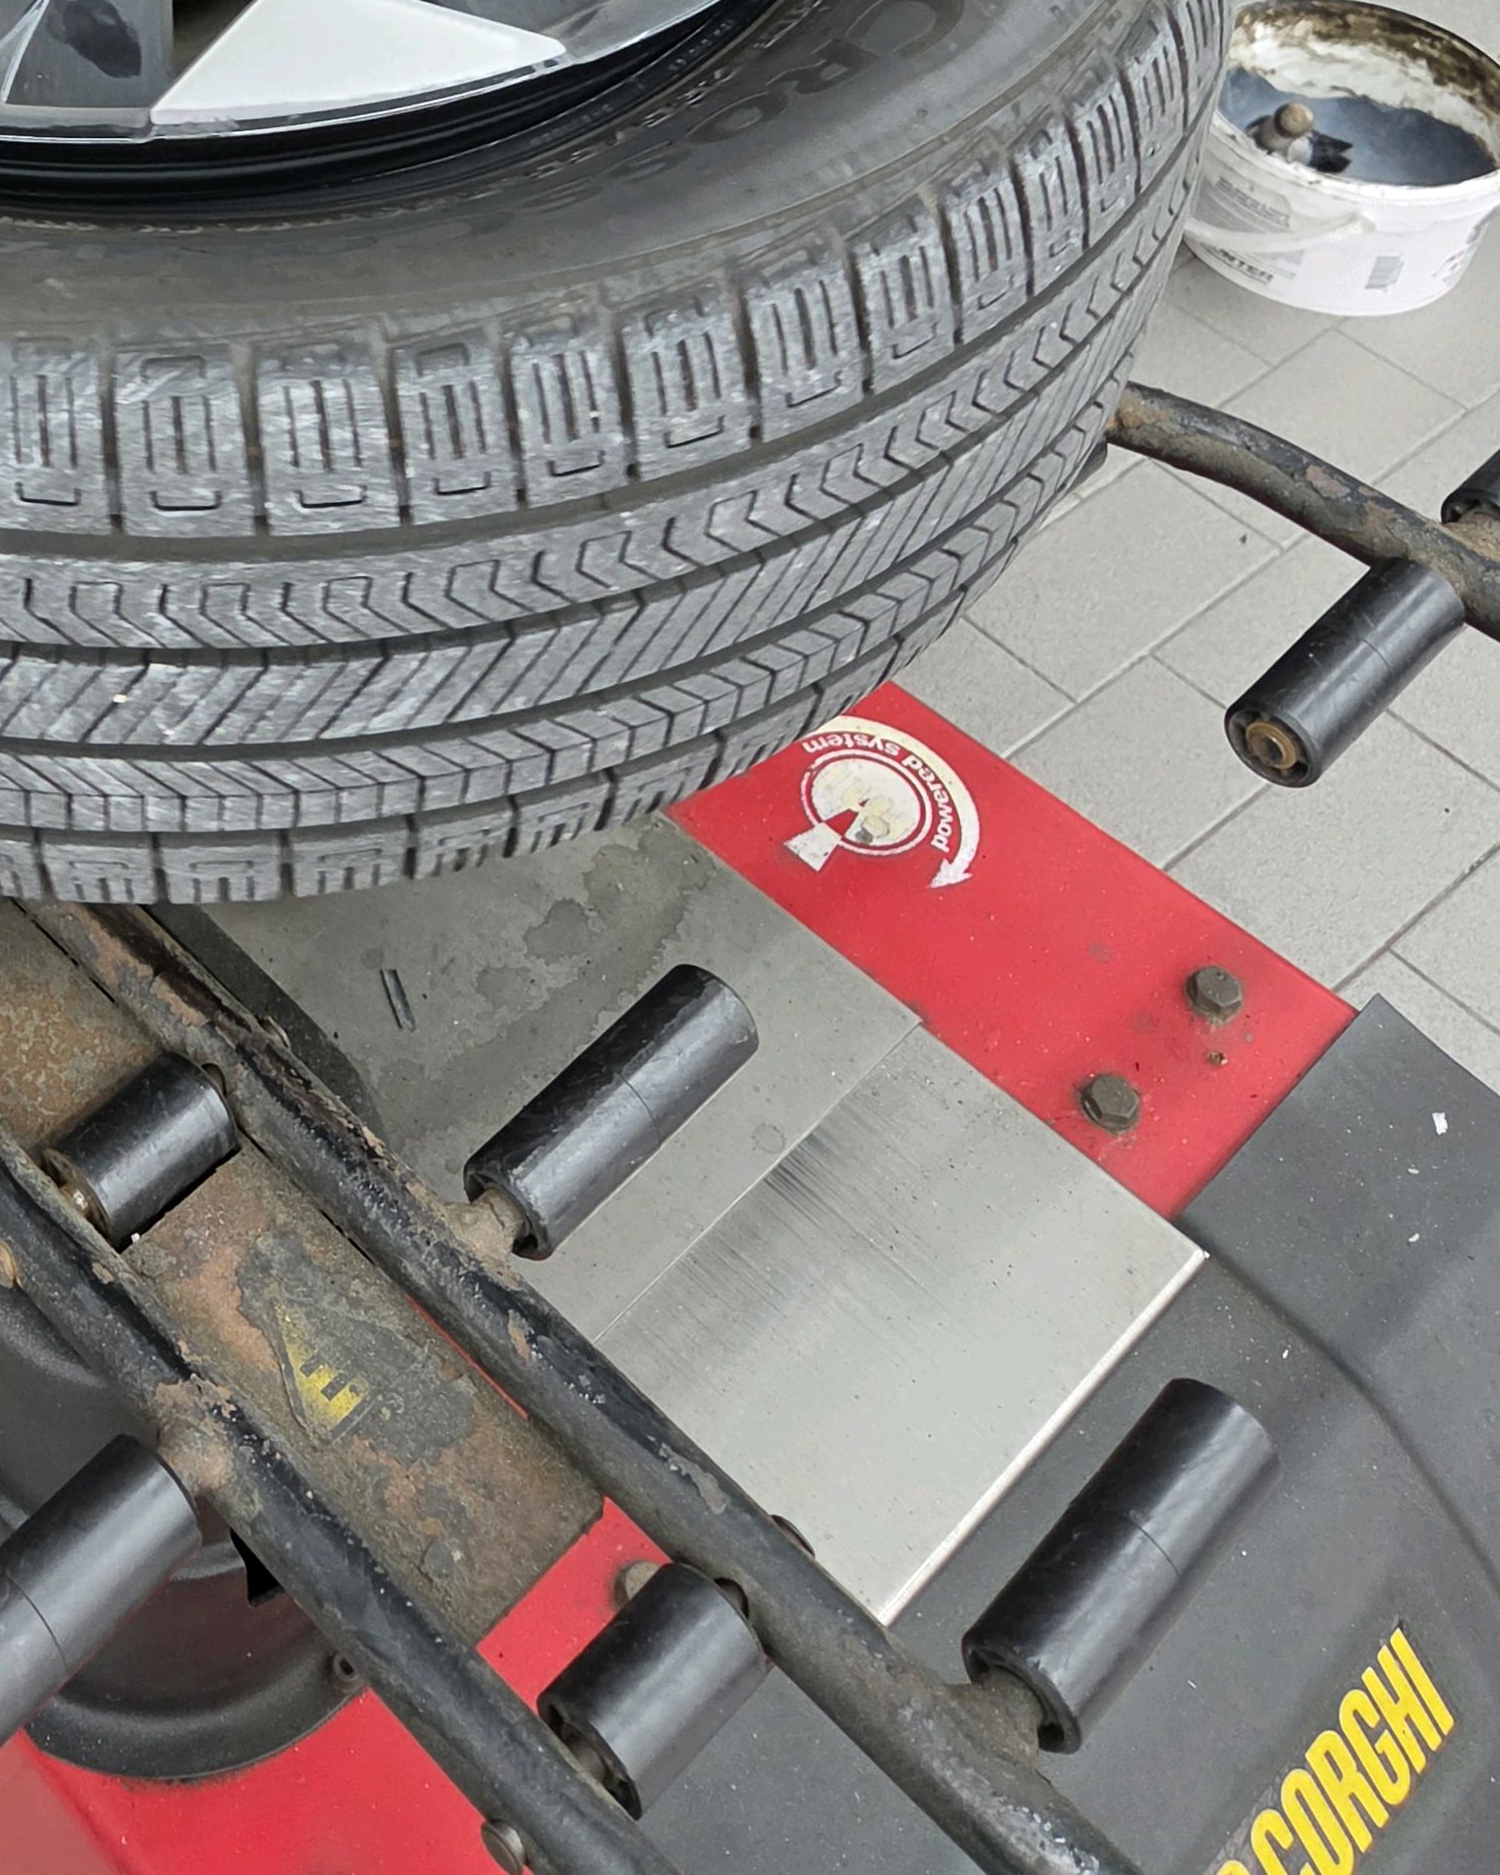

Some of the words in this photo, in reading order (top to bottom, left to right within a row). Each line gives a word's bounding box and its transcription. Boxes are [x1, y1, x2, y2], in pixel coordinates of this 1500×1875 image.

[802, 731, 900, 757] system
[901, 754, 953, 853] powered
[1251, 1627, 1455, 1875] CORGHI
